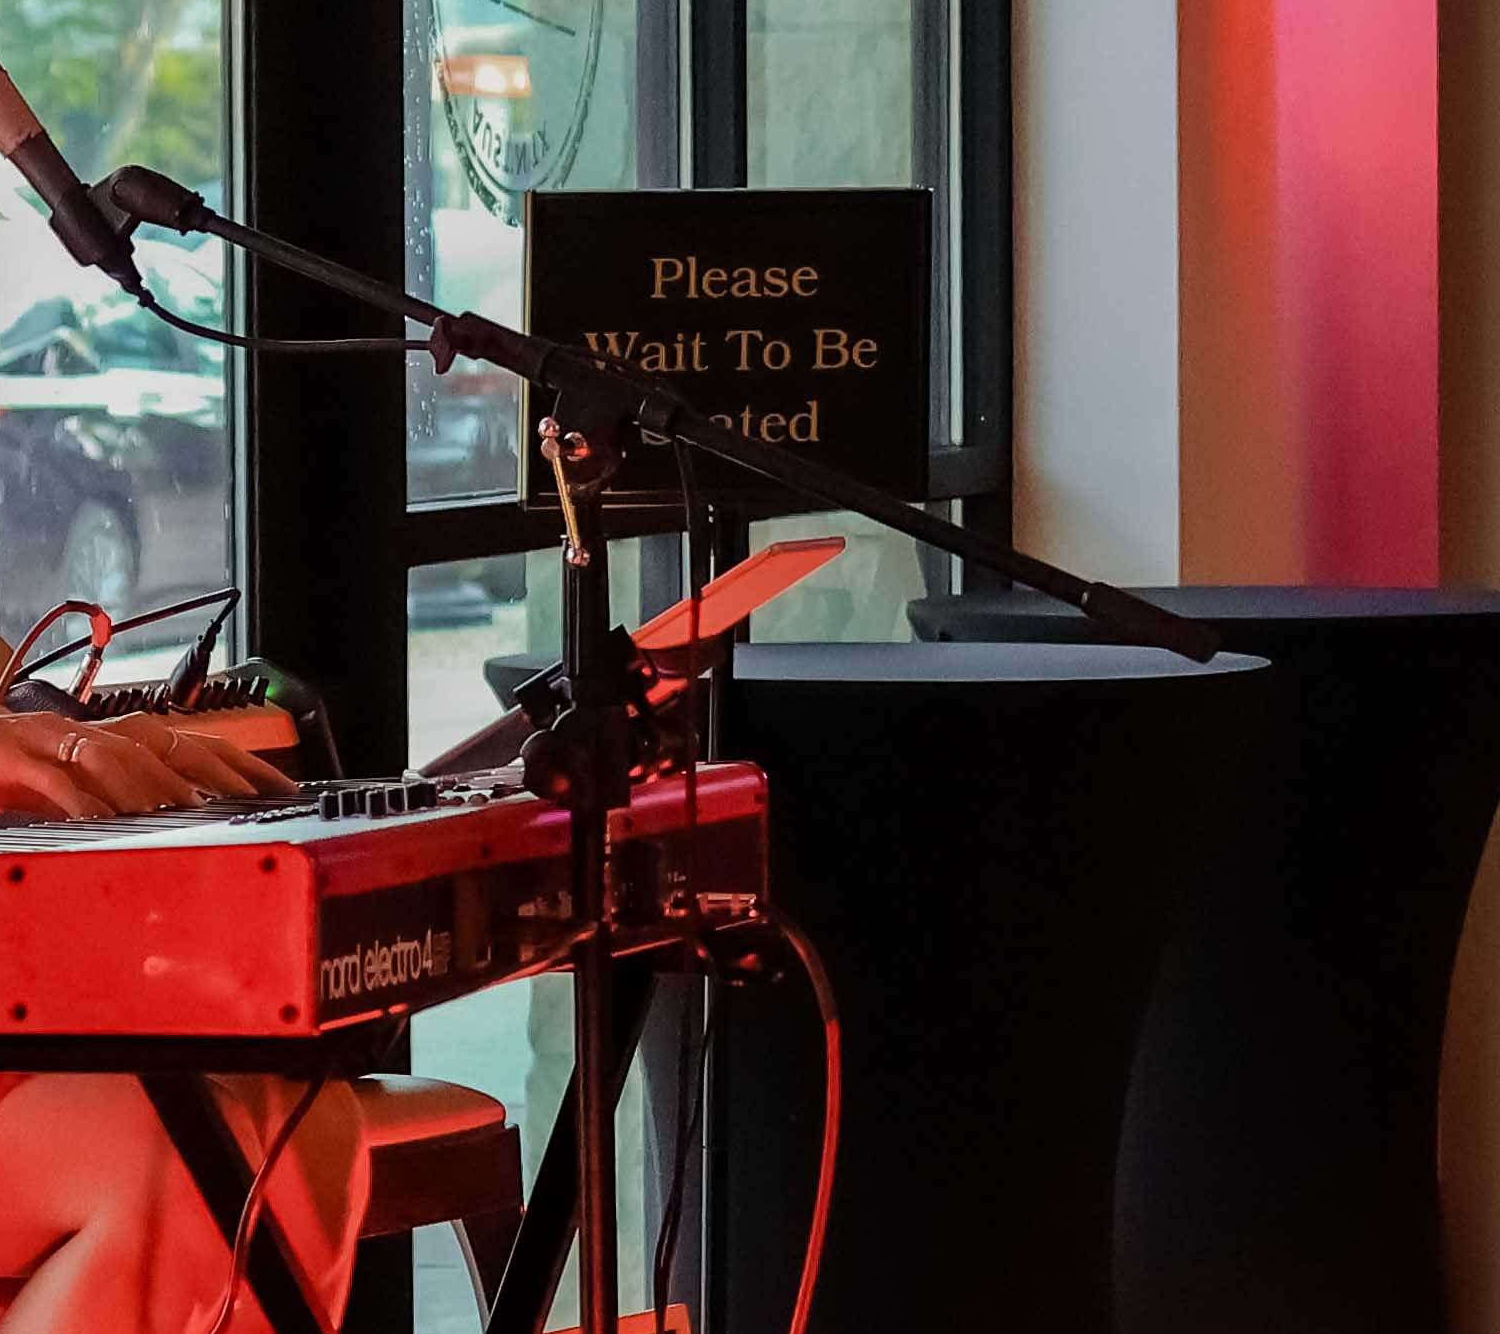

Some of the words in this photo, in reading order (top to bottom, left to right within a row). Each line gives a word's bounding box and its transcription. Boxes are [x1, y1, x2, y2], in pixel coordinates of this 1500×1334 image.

[651, 256, 819, 299] Please
[724, 328, 791, 371] To
[812, 328, 878, 370] Be
[320, 942, 361, 1001] nord
